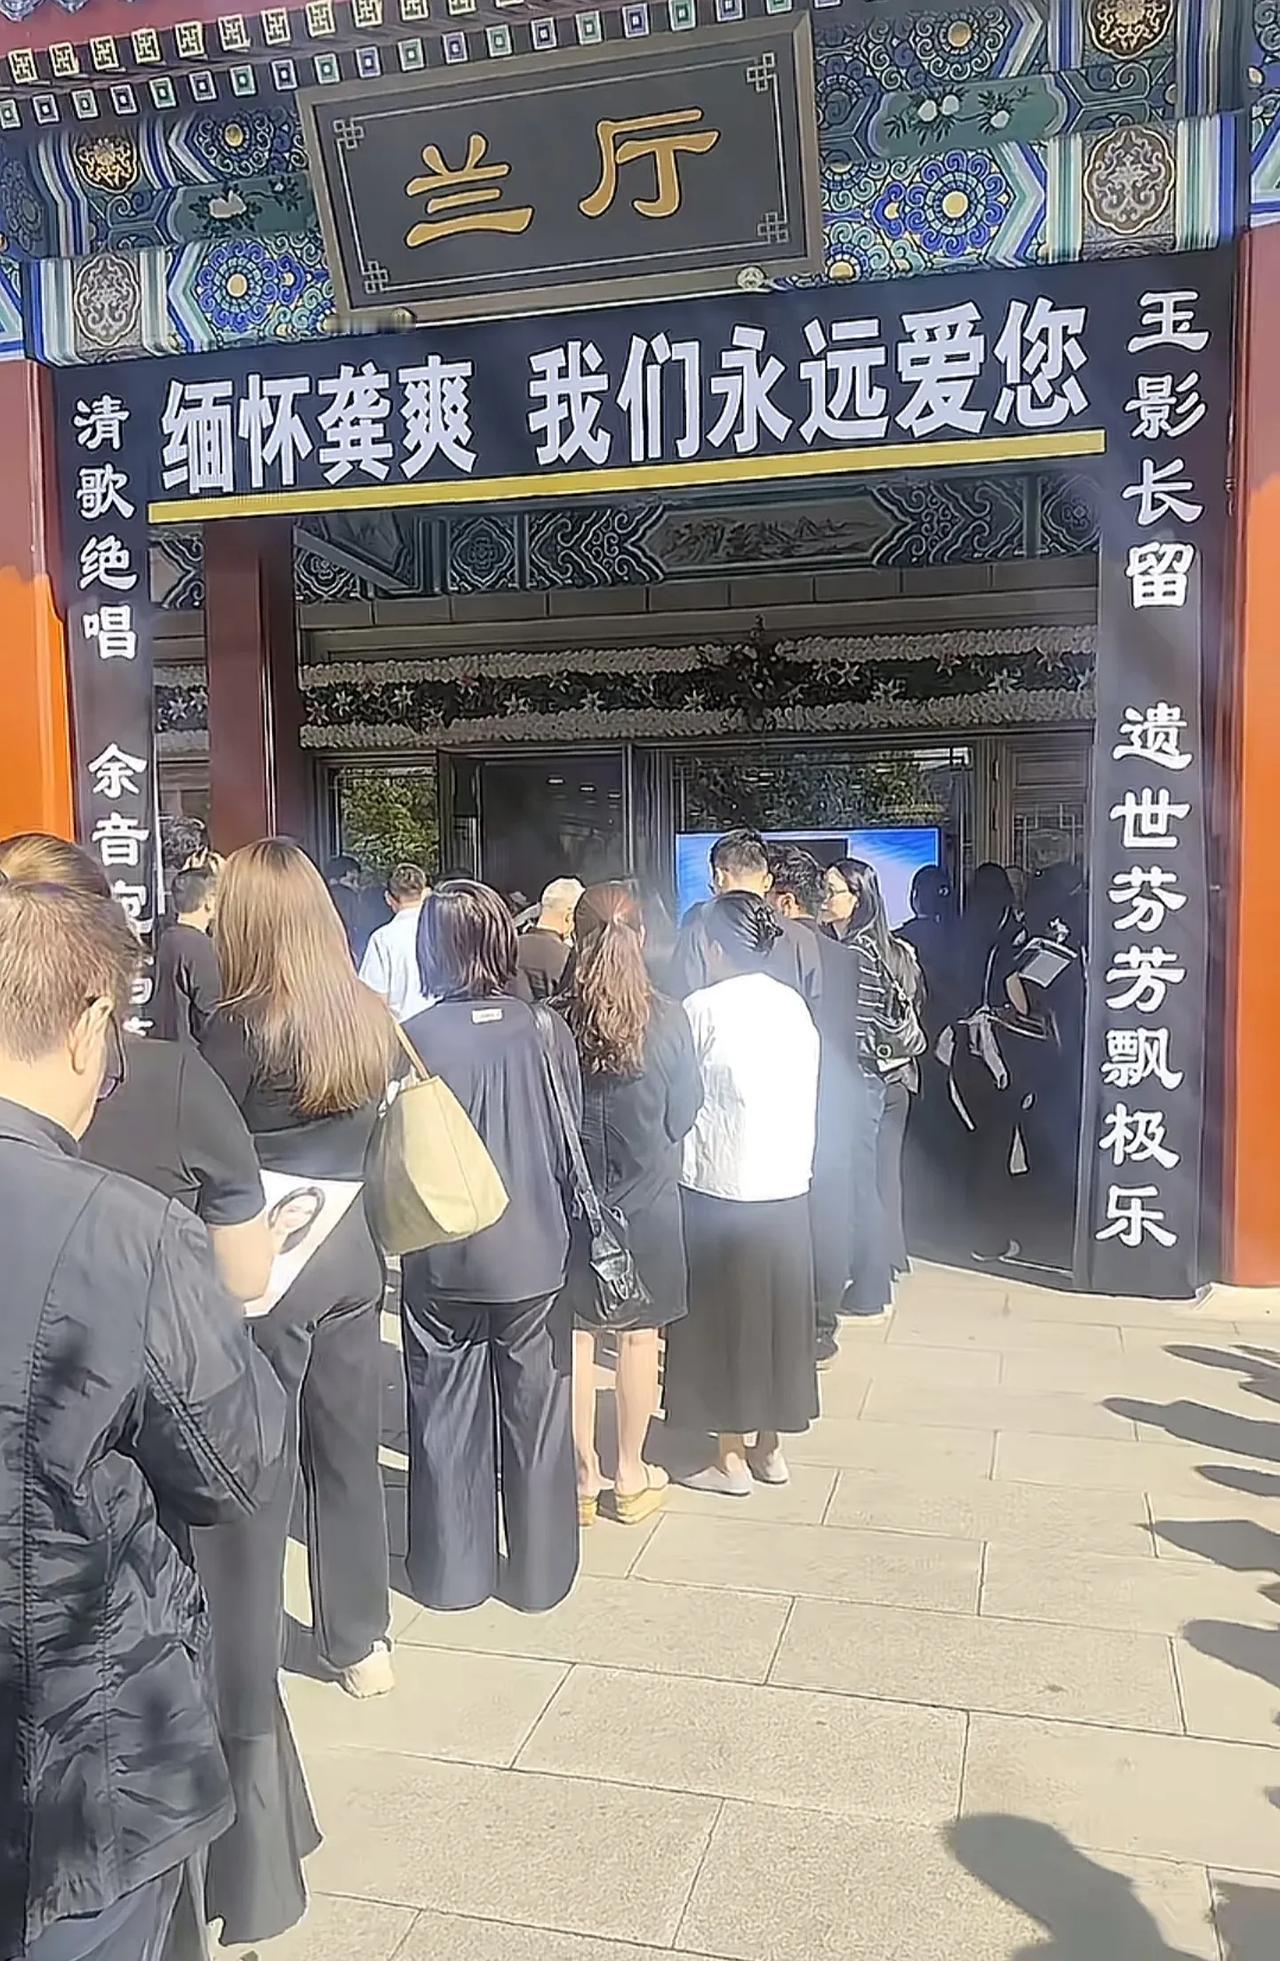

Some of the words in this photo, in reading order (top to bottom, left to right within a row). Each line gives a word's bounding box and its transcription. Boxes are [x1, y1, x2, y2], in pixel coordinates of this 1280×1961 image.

[405, 106, 720, 247] 兰厅
[161, 355, 477, 494] 缅怀龚爽
[527, 297, 1087, 466] 我们永远爱您
[1122, 290, 1210, 608] 玉影长留
[73, 398, 139, 660] 清歌绝唱
[1096, 701, 1193, 1247] 遗世芬芳飘极乐
